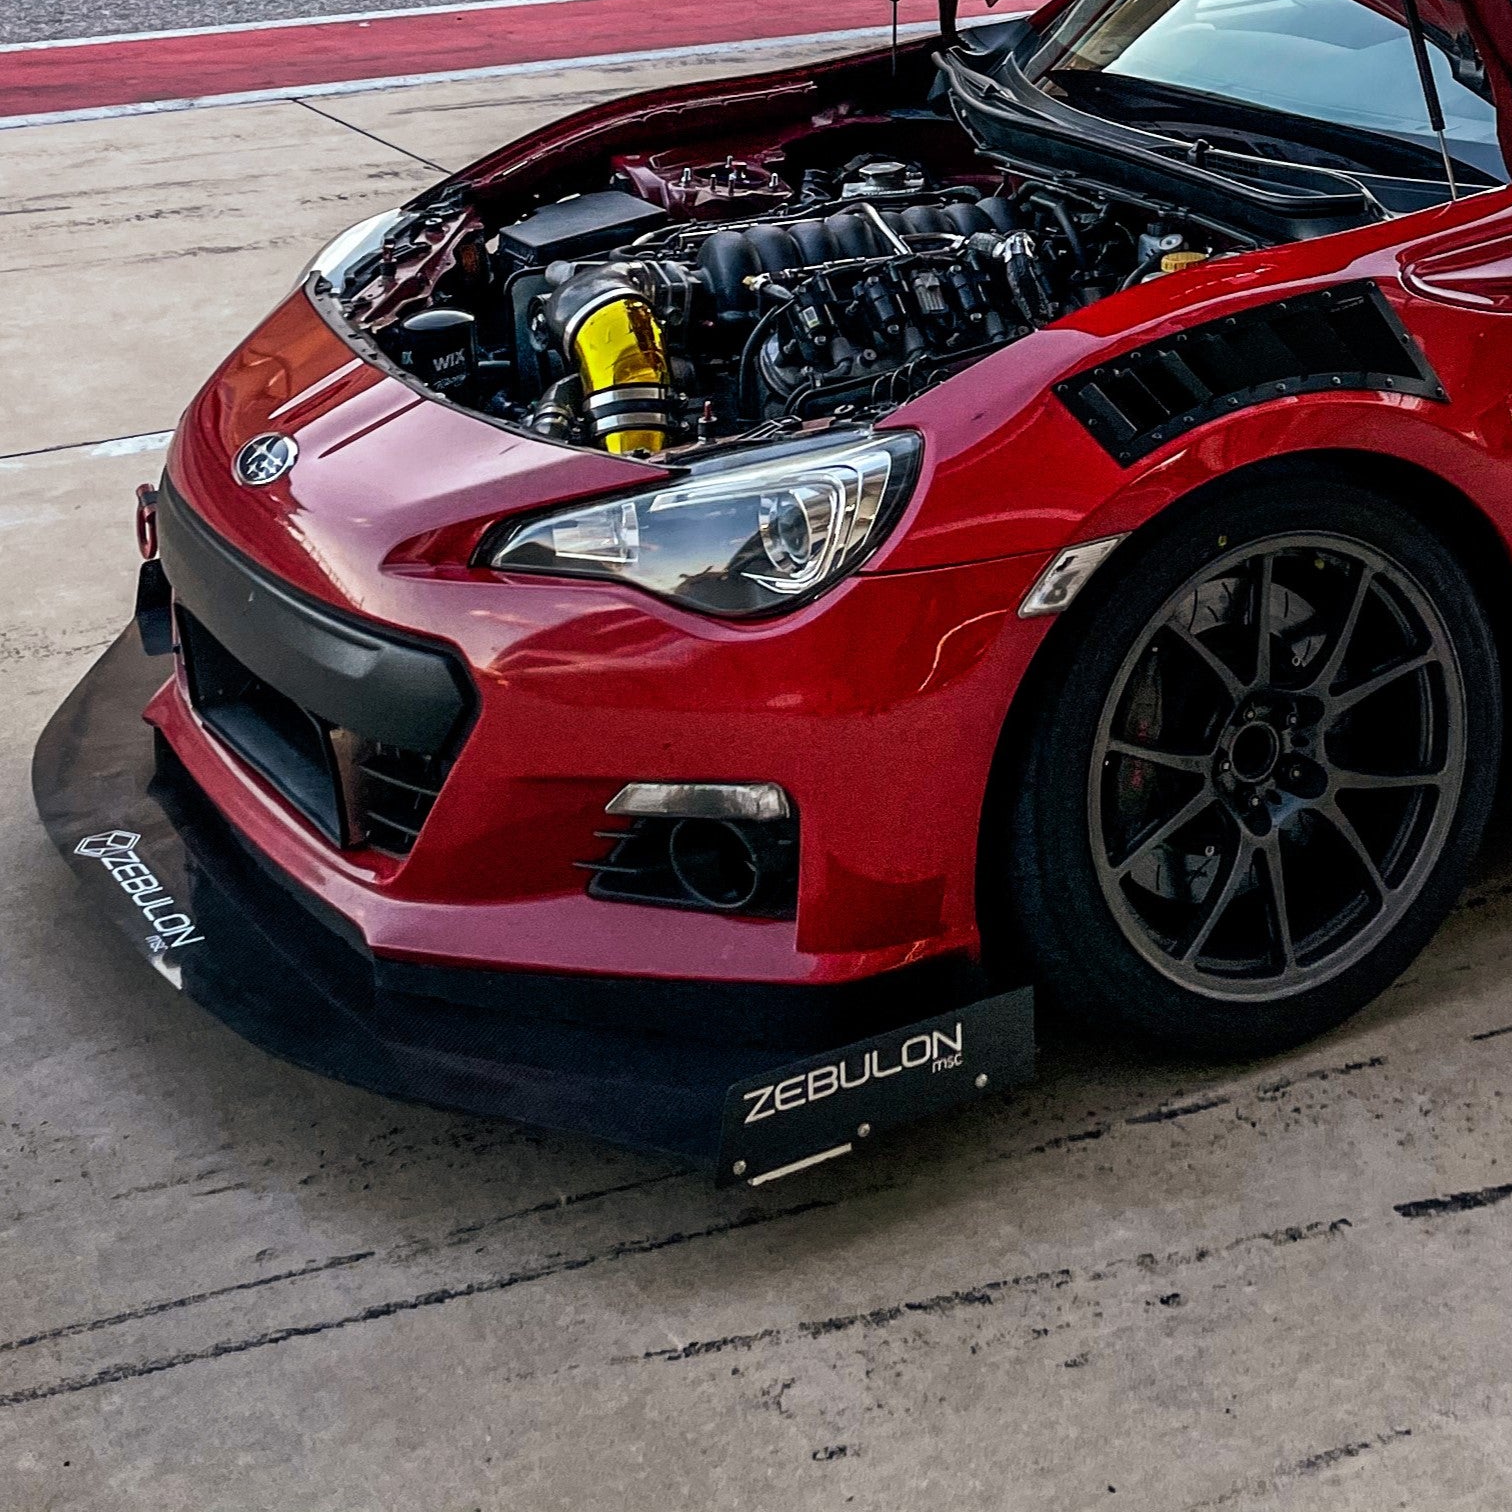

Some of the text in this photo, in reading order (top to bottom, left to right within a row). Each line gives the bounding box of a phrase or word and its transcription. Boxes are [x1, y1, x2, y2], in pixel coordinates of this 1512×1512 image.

[433, 348, 465, 371] WIX
[101, 850, 205, 948] ZEBULON
[743, 1022, 962, 1124] ZEBULON
[931, 1051, 963, 1074] msc
